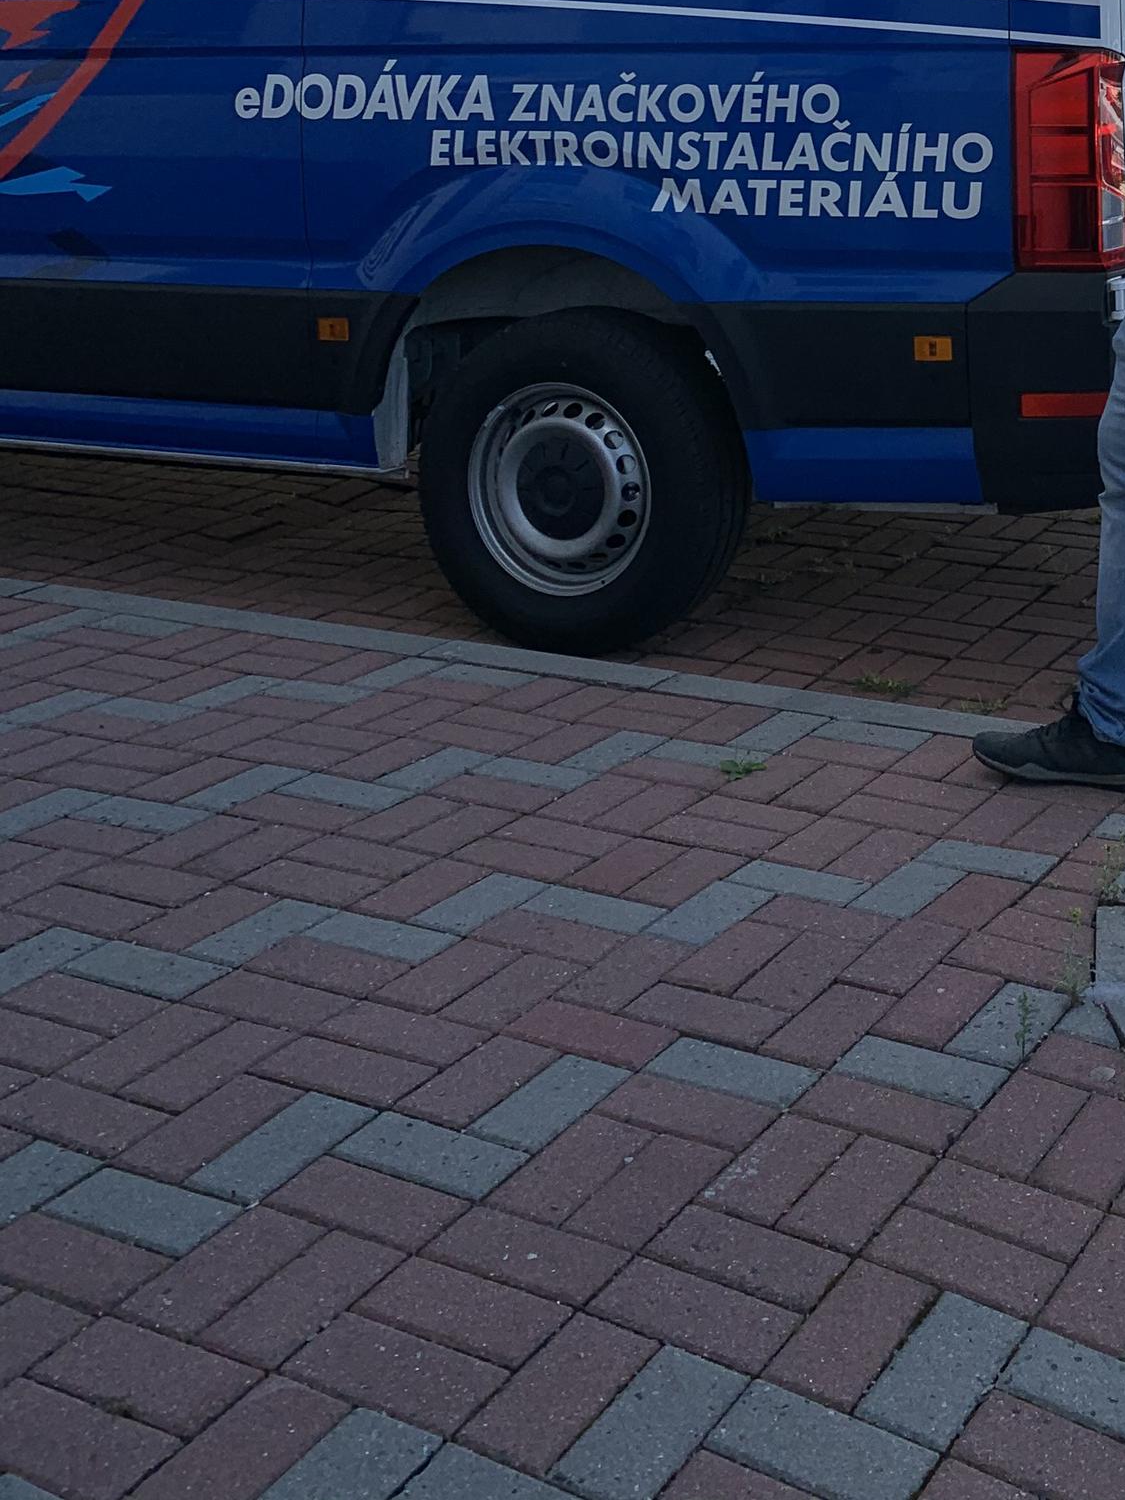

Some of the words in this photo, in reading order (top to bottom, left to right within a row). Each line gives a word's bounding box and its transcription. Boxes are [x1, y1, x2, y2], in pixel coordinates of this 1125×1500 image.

[233, 58, 496, 122] eDODÁVKA
[507, 70, 841, 124] ZNAČKOVÉHO
[429, 118, 995, 174] ELEKTROINSTALAČNÍHO
[650, 171, 984, 220] MATERIÁLU
